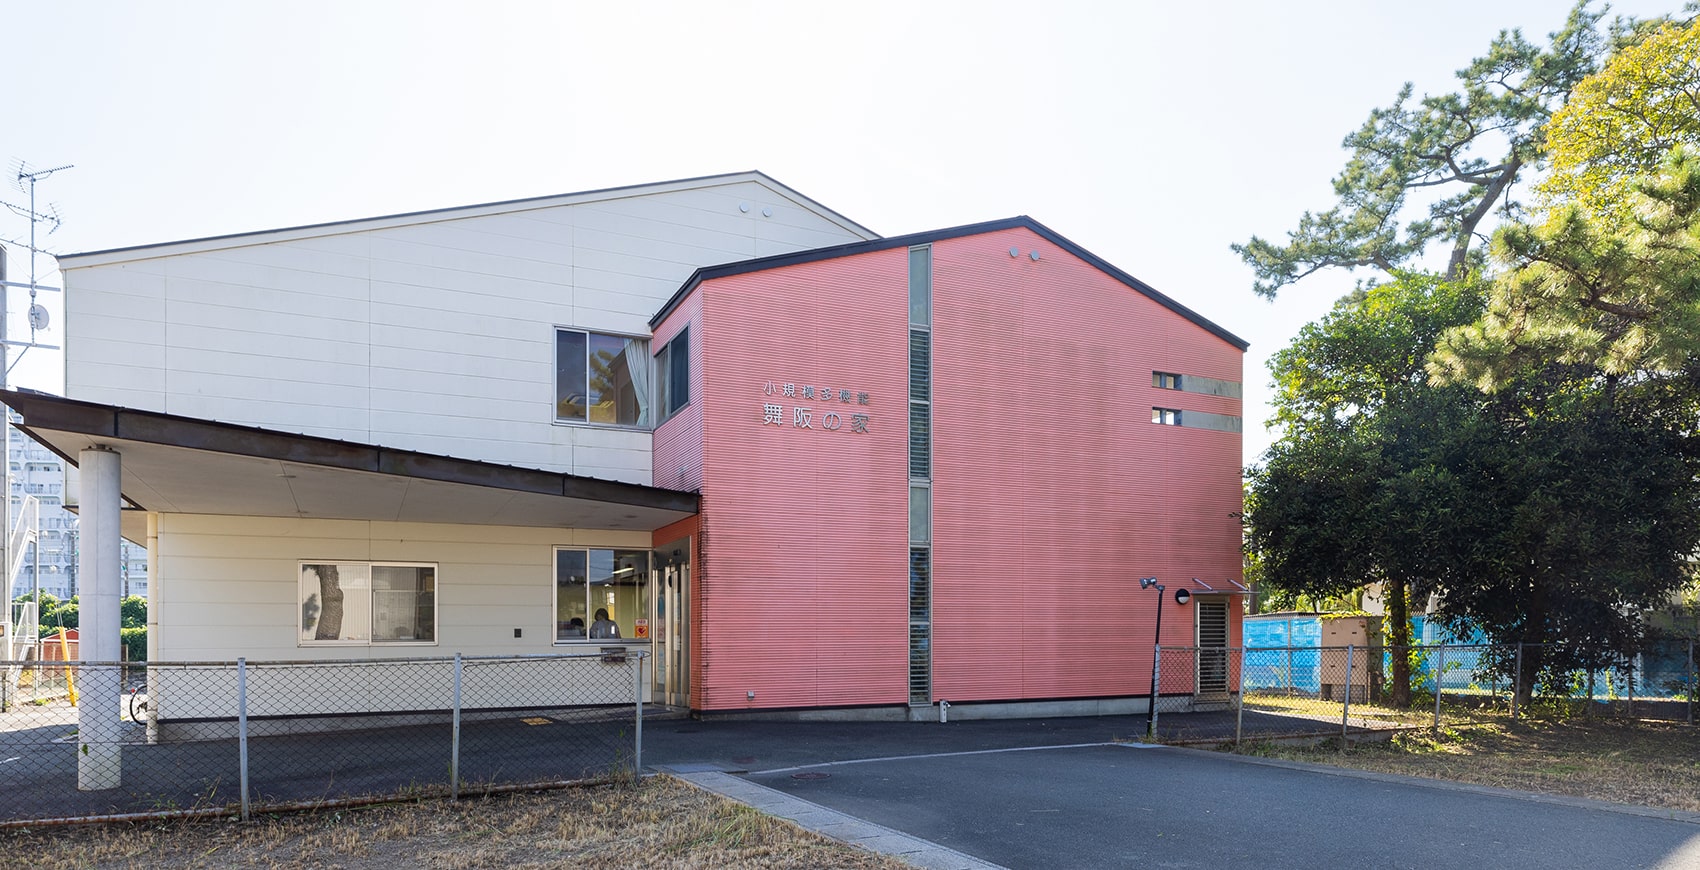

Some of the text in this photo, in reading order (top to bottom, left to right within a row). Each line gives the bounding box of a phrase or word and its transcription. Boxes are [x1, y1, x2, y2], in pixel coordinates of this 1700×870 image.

[763, 380, 870, 405] 小規模多機能
[762, 402, 870, 433] 舞阪の家
